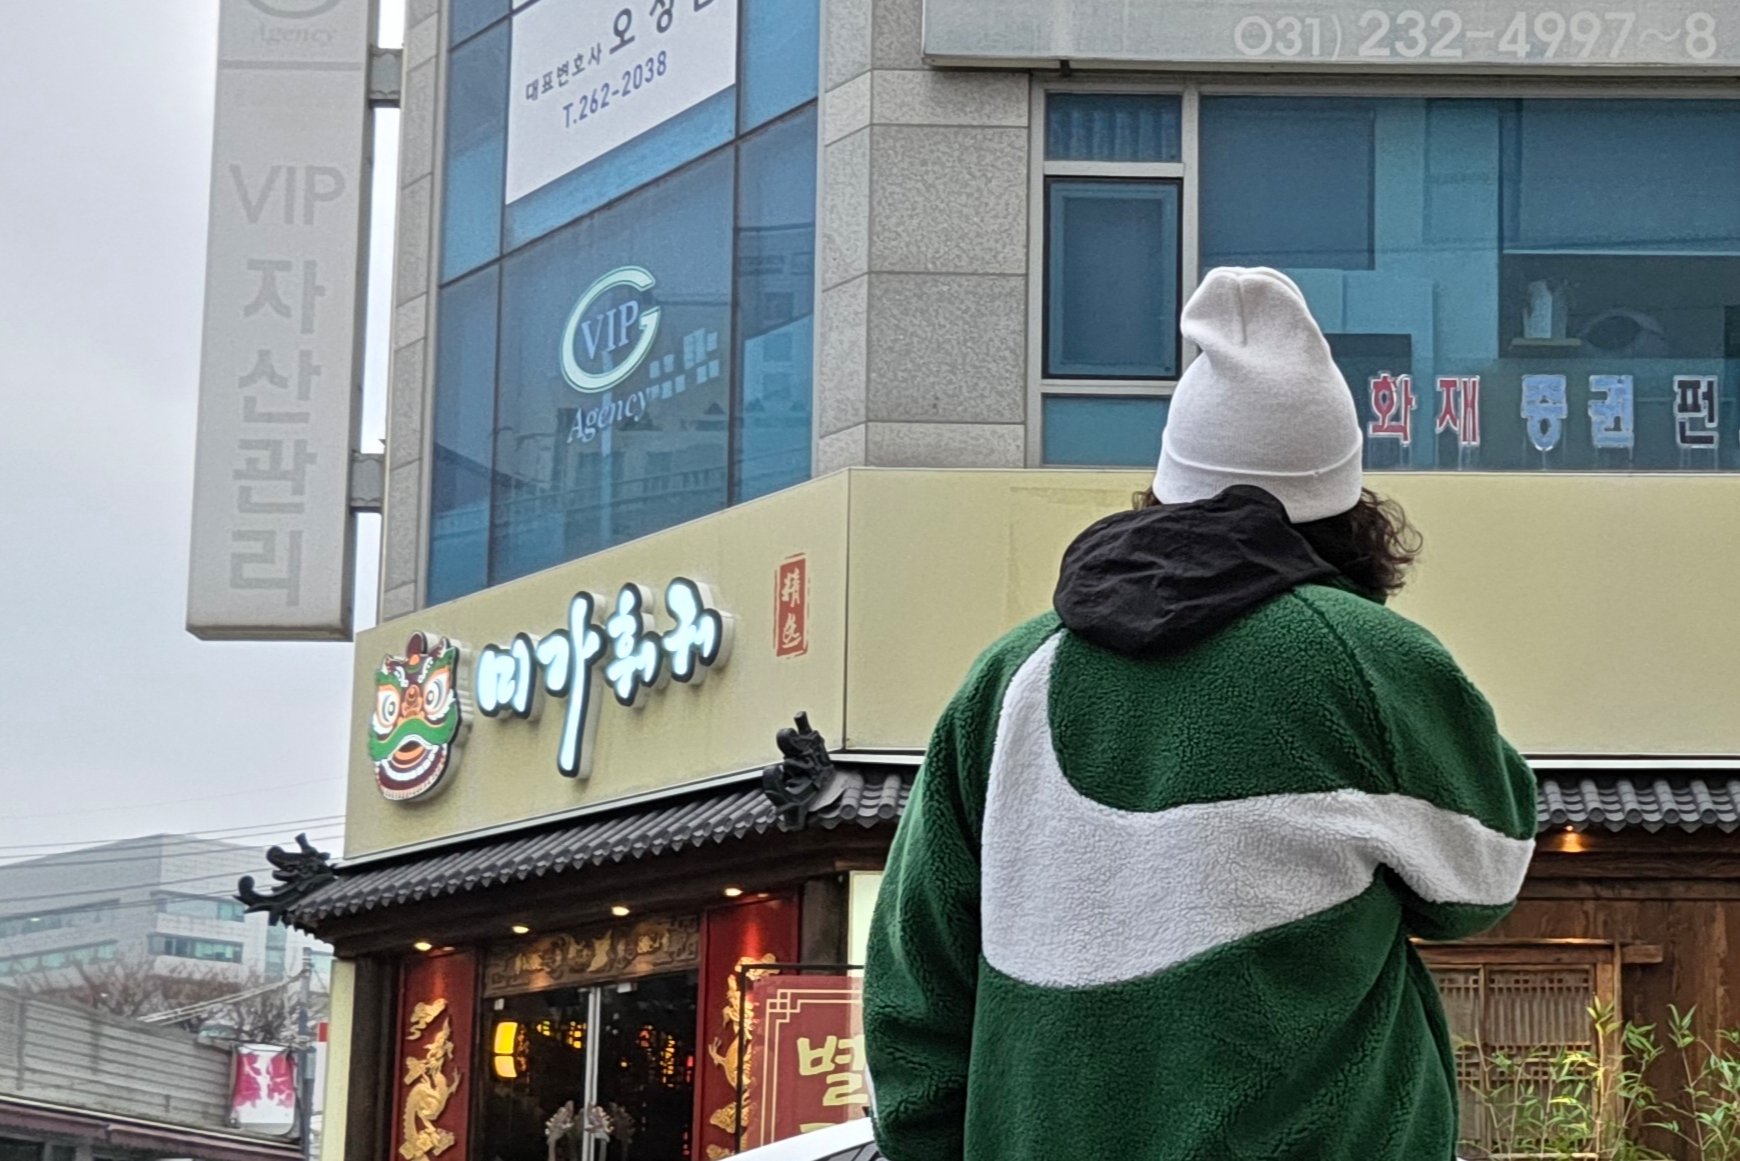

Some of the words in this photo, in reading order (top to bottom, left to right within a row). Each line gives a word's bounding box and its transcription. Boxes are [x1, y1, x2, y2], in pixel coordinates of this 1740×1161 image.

[526, 42, 602, 101] 대표변호사
[563, 50, 667, 128] T.262-2038
[229, 164, 346, 226] VIP
[581, 300, 639, 360] VIP
[230, 258, 326, 607] 자산관리
[567, 390, 649, 443] Agency
[1368, 370, 1480, 447] 화재
[1673, 375, 1740, 448] 펀
